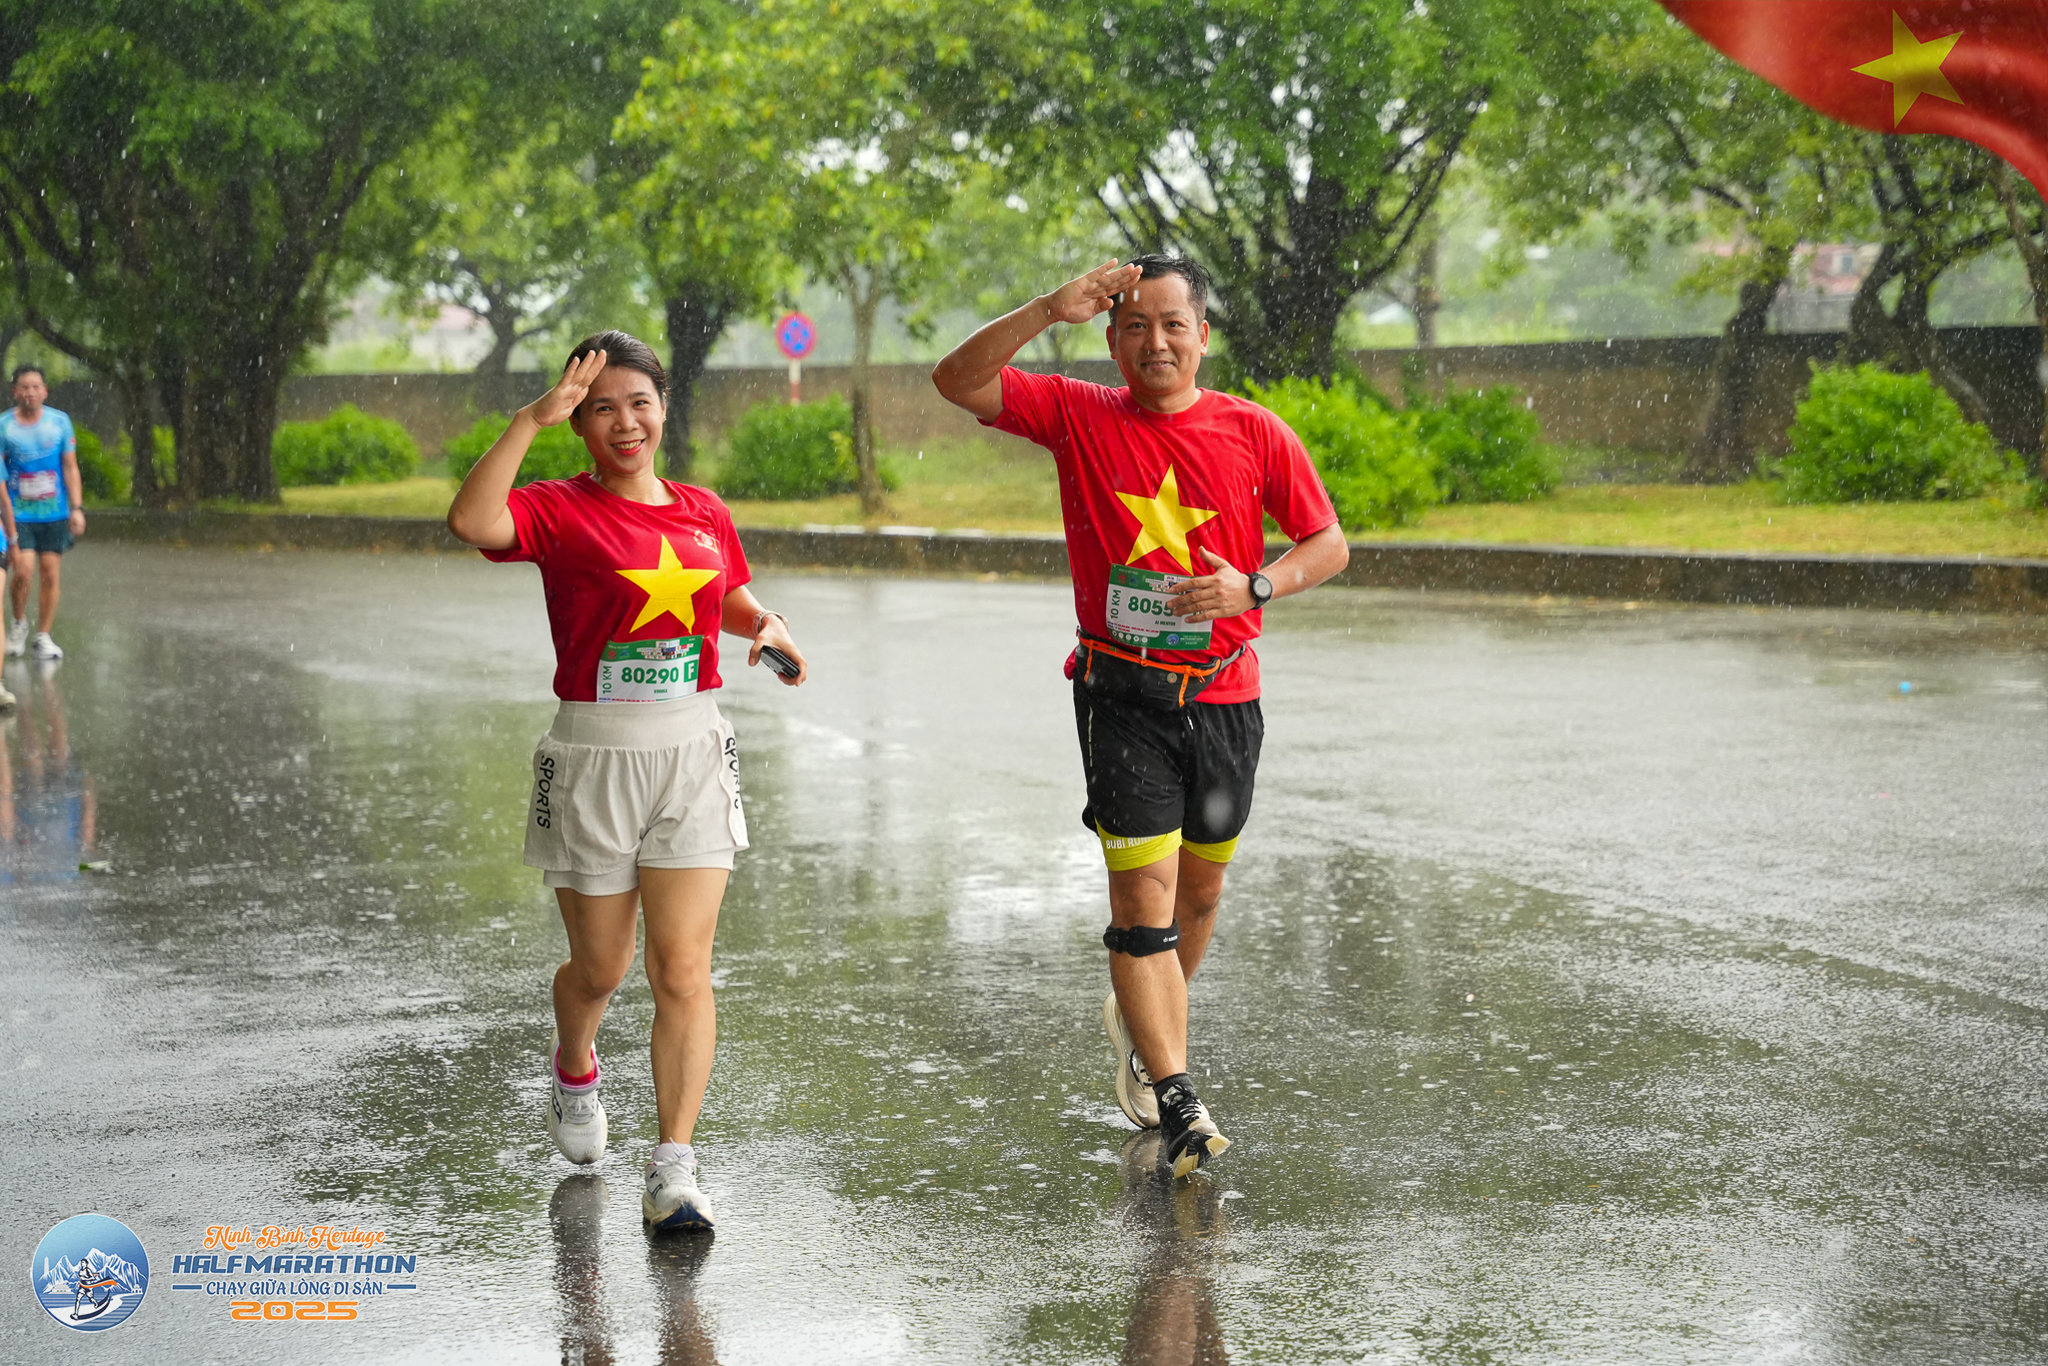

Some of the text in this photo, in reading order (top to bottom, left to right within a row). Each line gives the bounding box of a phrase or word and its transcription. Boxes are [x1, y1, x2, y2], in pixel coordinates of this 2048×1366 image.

[1110, 589, 1121, 619] 10 KM
[602, 666, 612, 694] 10 KM
[621, 662, 695, 685] 80290 F
[536, 755, 555, 829] SPORTS
[1105, 838, 1126, 849] BUBI
